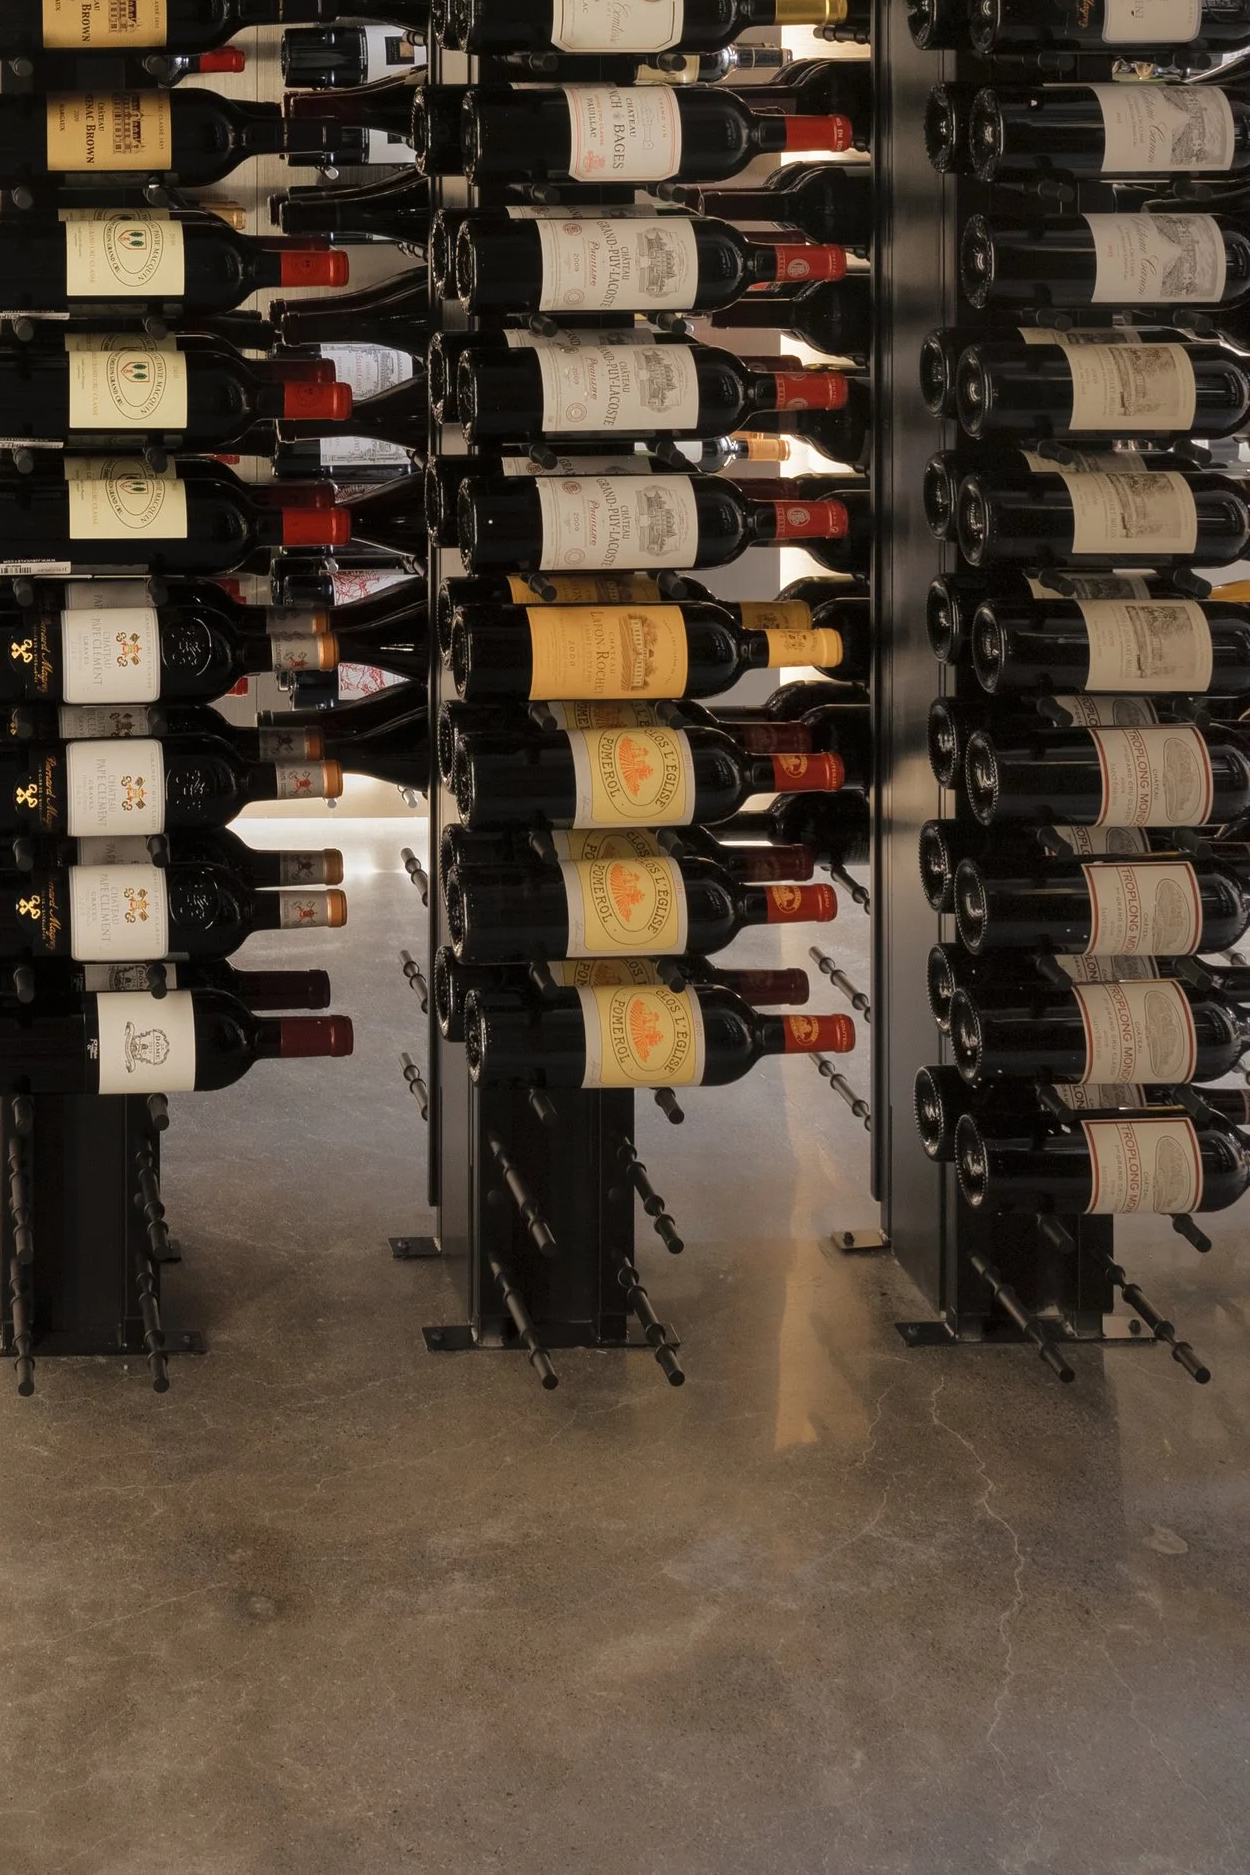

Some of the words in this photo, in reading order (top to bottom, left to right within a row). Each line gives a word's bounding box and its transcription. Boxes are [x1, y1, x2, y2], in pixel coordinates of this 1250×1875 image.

[81, 4, 92, 42] BROWN
[86, 124, 96, 164] BROWN
[612, 124, 625, 169] BAGES
[137, 247, 161, 281] MACQUIN
[620, 246, 631, 281] CHÂTEAU
[139, 380, 163, 415] MACQUIN
[140, 492, 162, 524] MACQUIN
[620, 505, 631, 539] CHÂTEAU
[644, 728, 670, 748] CLOS
[601, 737, 621, 799] POMEROL
[1129, 729, 1149, 788] TROPLONG
[592, 863, 613, 924] POMEROL
[1121, 867, 1139, 932] TROPLONG
[655, 989, 680, 1013] CLOS
[1108, 983, 1132, 1042] TROPLONG
[612, 999, 629, 1064] POMEROL
[1119, 1125, 1140, 1191] TROPLONG
